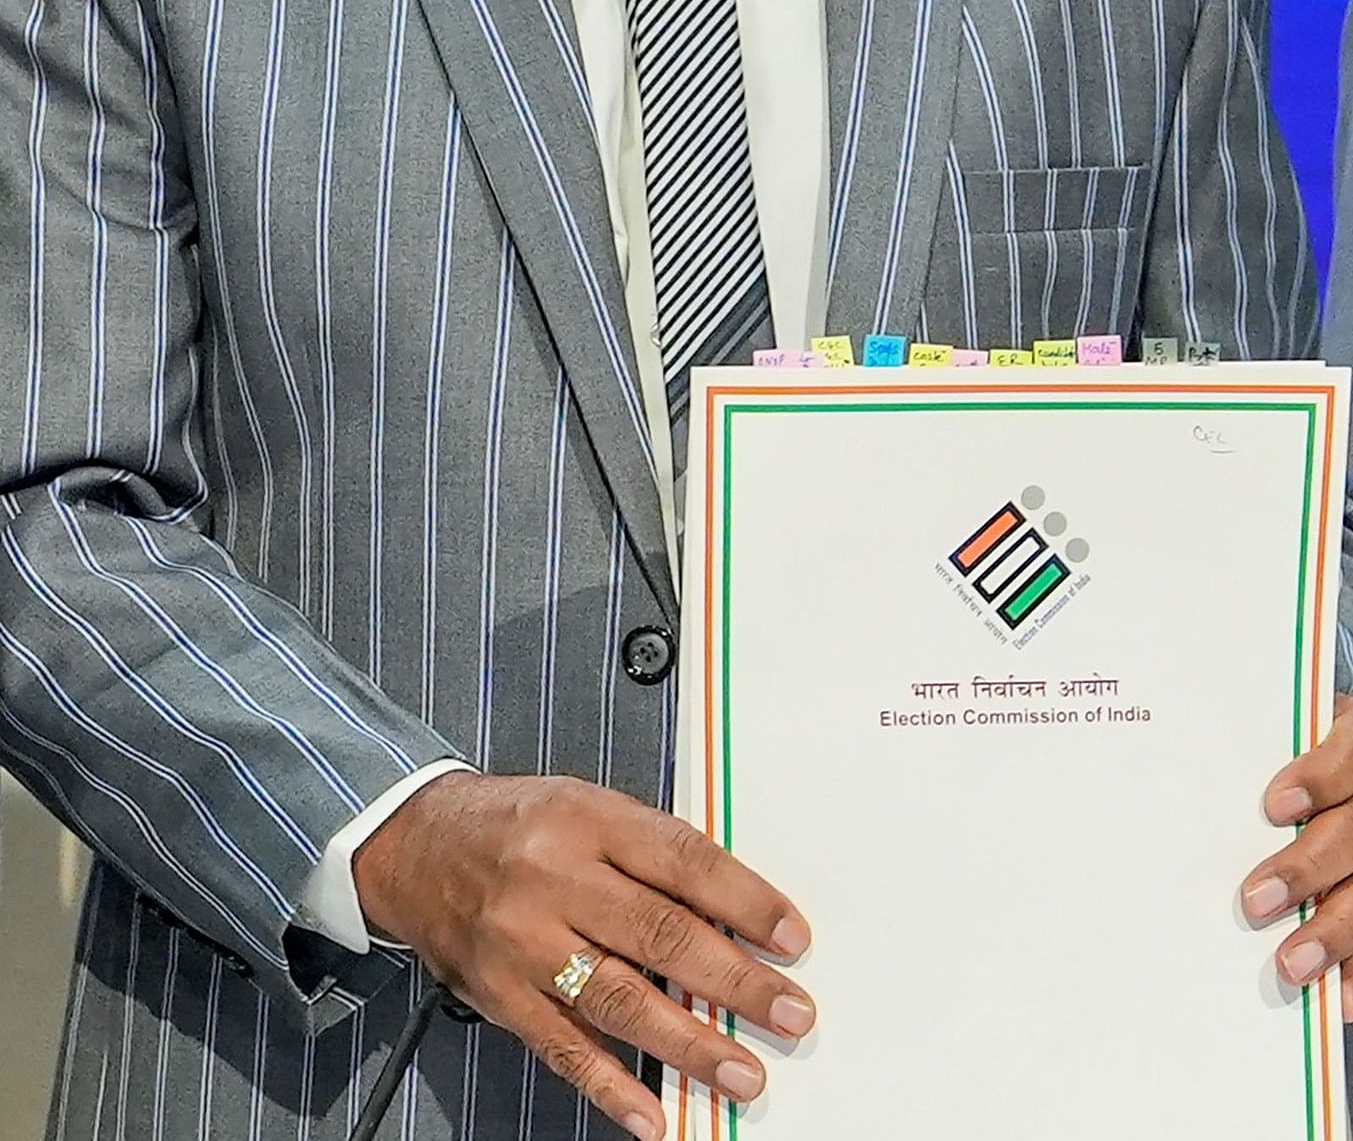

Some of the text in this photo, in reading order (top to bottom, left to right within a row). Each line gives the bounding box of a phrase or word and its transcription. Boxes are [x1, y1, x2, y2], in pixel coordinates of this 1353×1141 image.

[911, 673, 1120, 700] भारत निर्वाचन आयोग
[879, 706, 1152, 727] Election Commission of India
